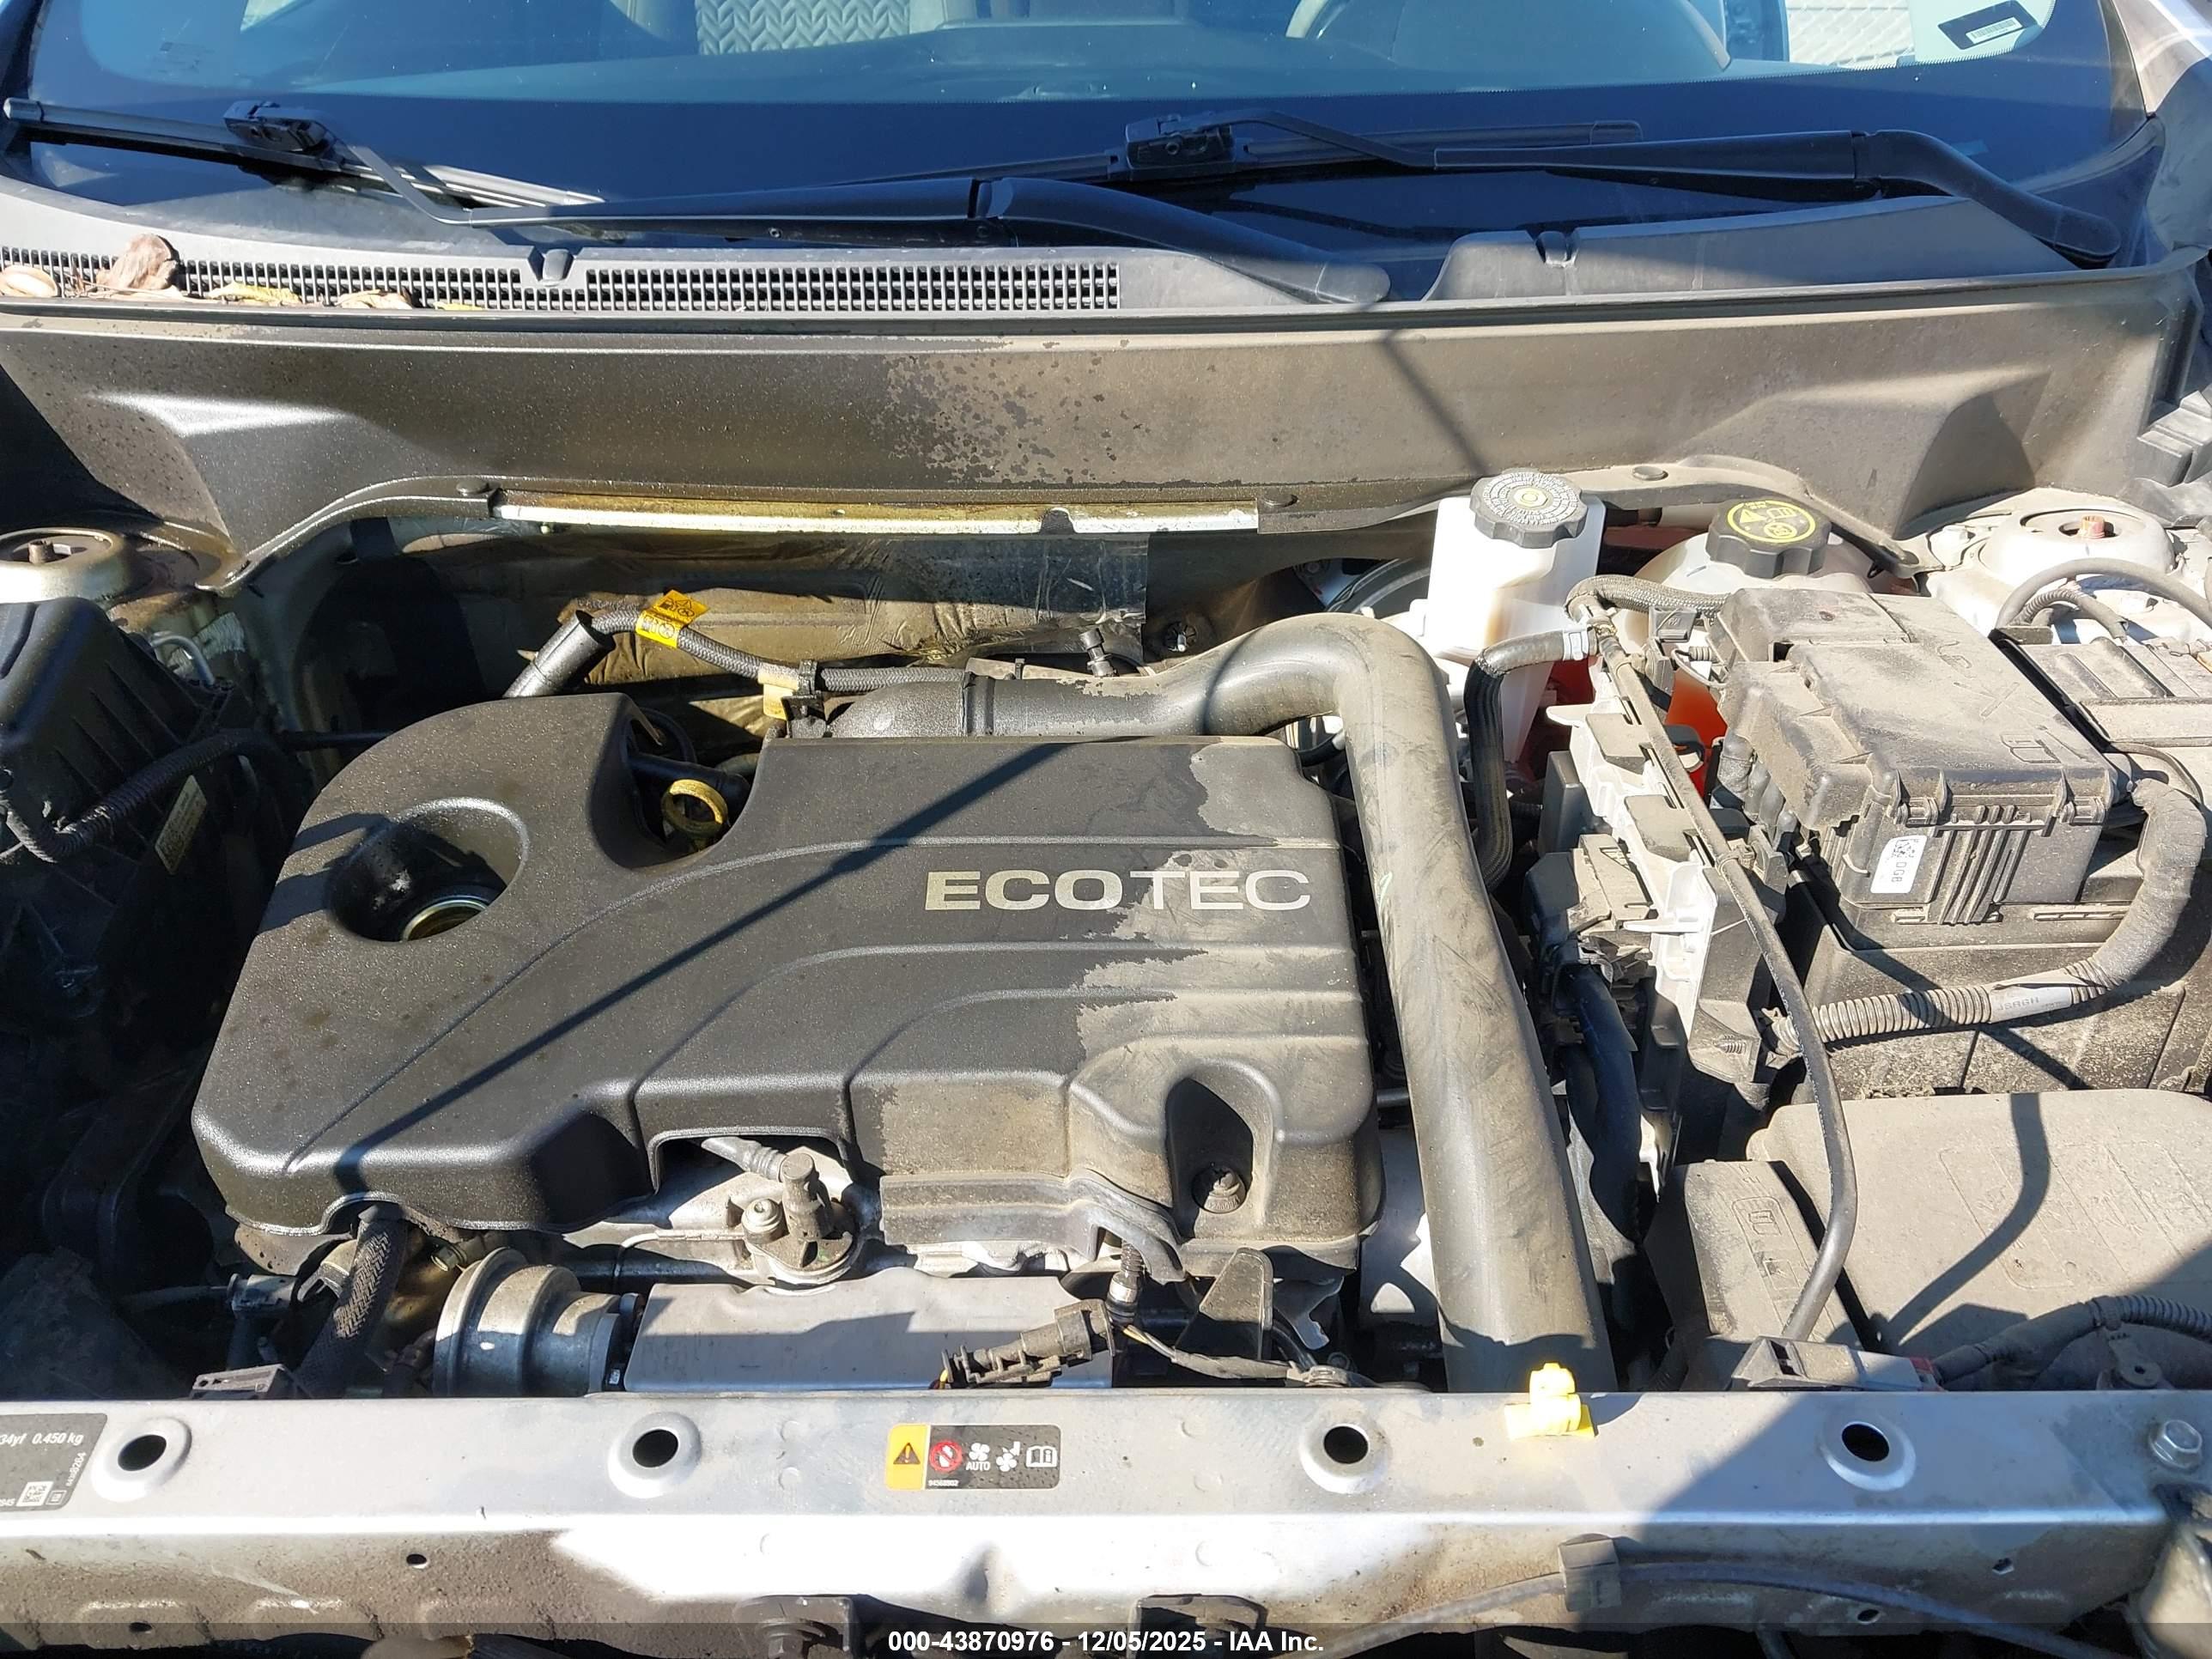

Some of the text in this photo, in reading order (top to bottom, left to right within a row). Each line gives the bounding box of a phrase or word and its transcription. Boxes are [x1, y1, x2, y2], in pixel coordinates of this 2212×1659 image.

[925, 869, 1310, 910] ECOTEC
[31, 1432, 67, 1444] 0.450
[67, 1432, 84, 1446] kg
[965, 1462, 991, 1471] AUTO
